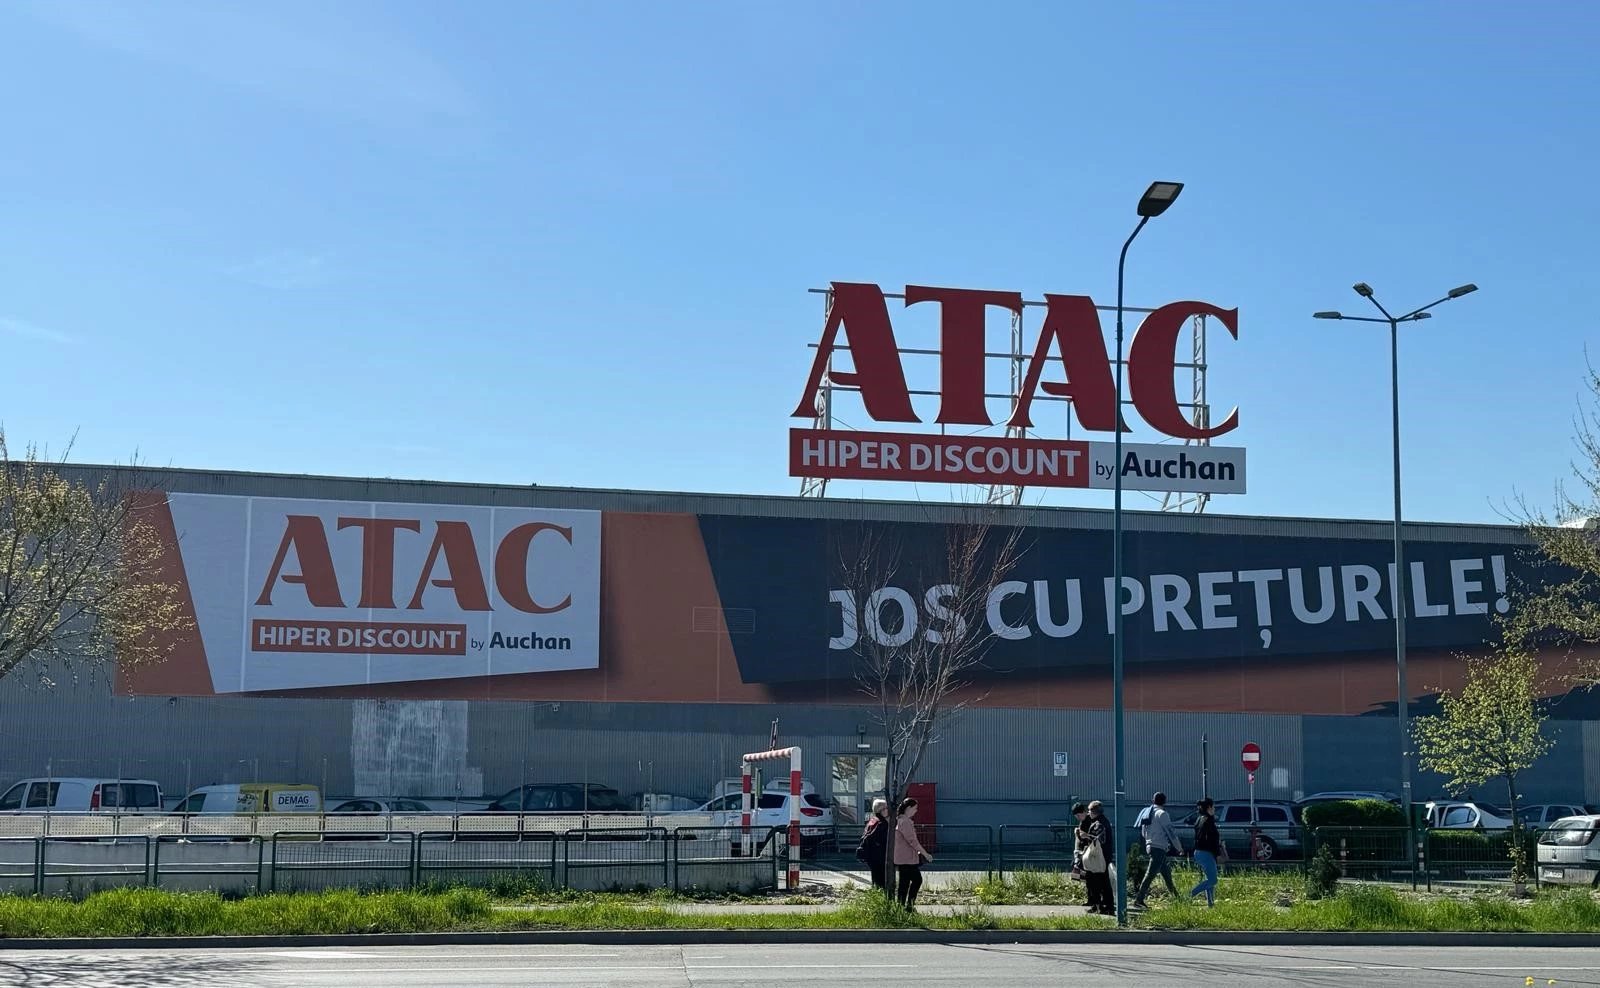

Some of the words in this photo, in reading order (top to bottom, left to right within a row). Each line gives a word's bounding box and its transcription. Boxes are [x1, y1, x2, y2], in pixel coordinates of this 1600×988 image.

[790, 281, 1239, 439] ATAC
[802, 438, 901, 470] HIPER
[911, 443, 1081, 477] DISCOUNT
[1095, 460, 1115, 480] by
[1121, 451, 1236, 481] Auchan
[254, 515, 573, 614] ATAC
[259, 626, 332, 647] HIPER
[337, 628, 461, 649] DISCOUNT
[471, 637, 485, 651] by
[488, 631, 572, 650] Auchan
[828, 584, 967, 650] JOS
[985, 578, 1084, 640] CU
[278, 795, 309, 805] DEMAG
